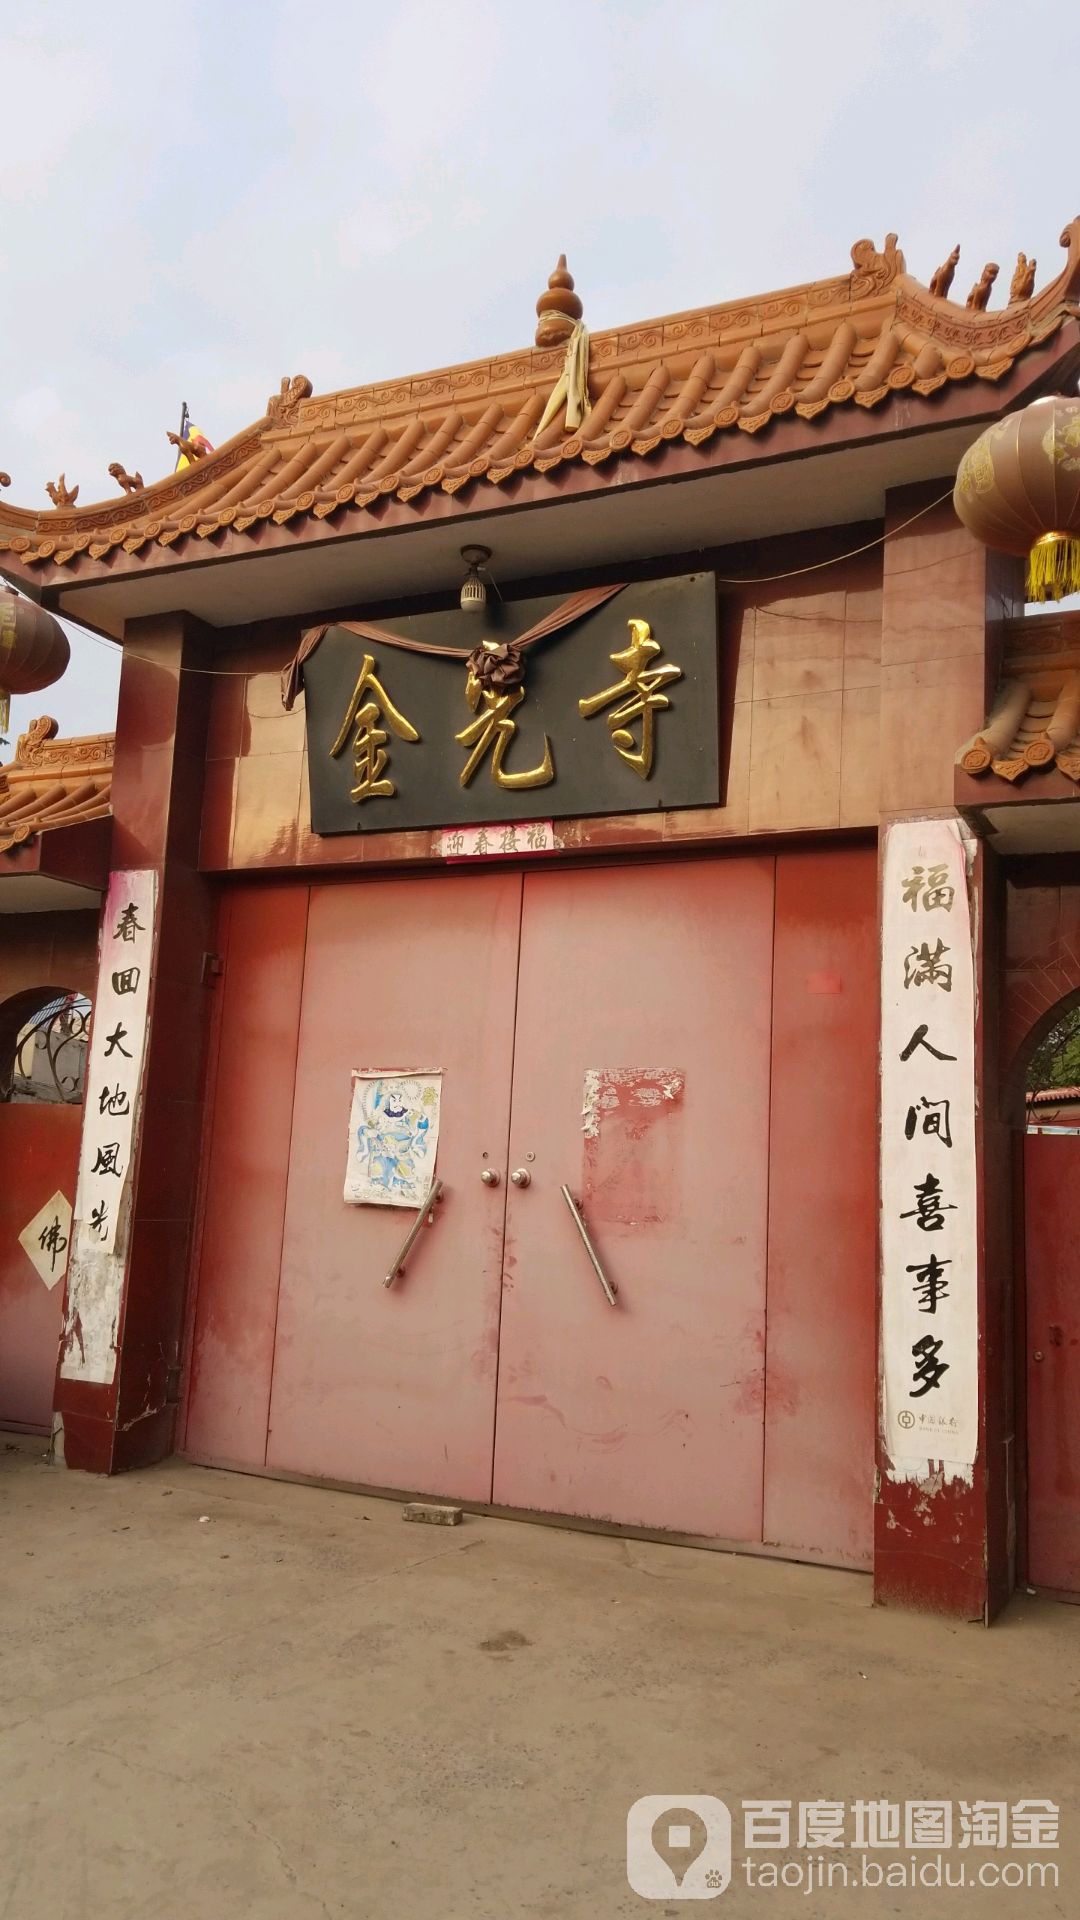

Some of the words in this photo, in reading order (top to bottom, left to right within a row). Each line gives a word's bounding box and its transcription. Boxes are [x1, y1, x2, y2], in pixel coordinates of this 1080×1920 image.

[446, 822, 548, 856] 迎春接福
[38, 1215, 67, 1273] 佛
